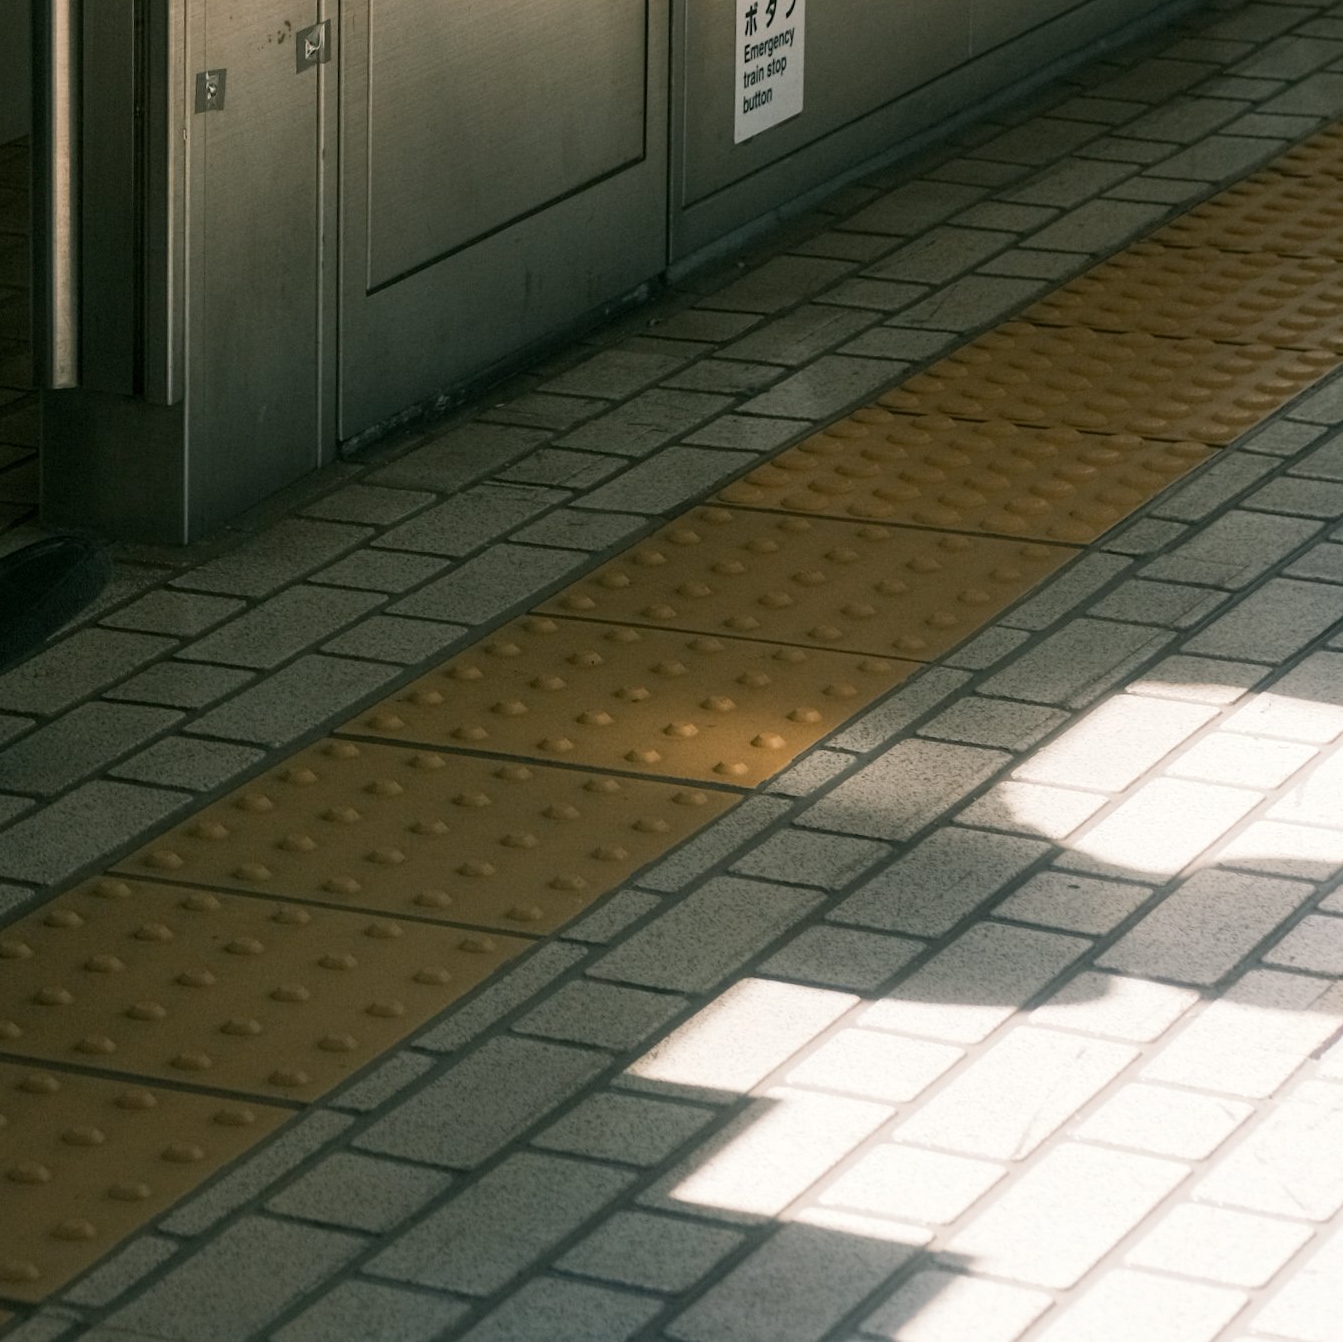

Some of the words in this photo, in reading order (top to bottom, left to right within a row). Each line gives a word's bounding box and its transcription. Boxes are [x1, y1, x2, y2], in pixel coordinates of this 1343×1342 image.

[744, 27, 795, 64] Emergency
[743, 60, 765, 89] train
[767, 55, 787, 78] stop
[742, 86, 773, 115] button
